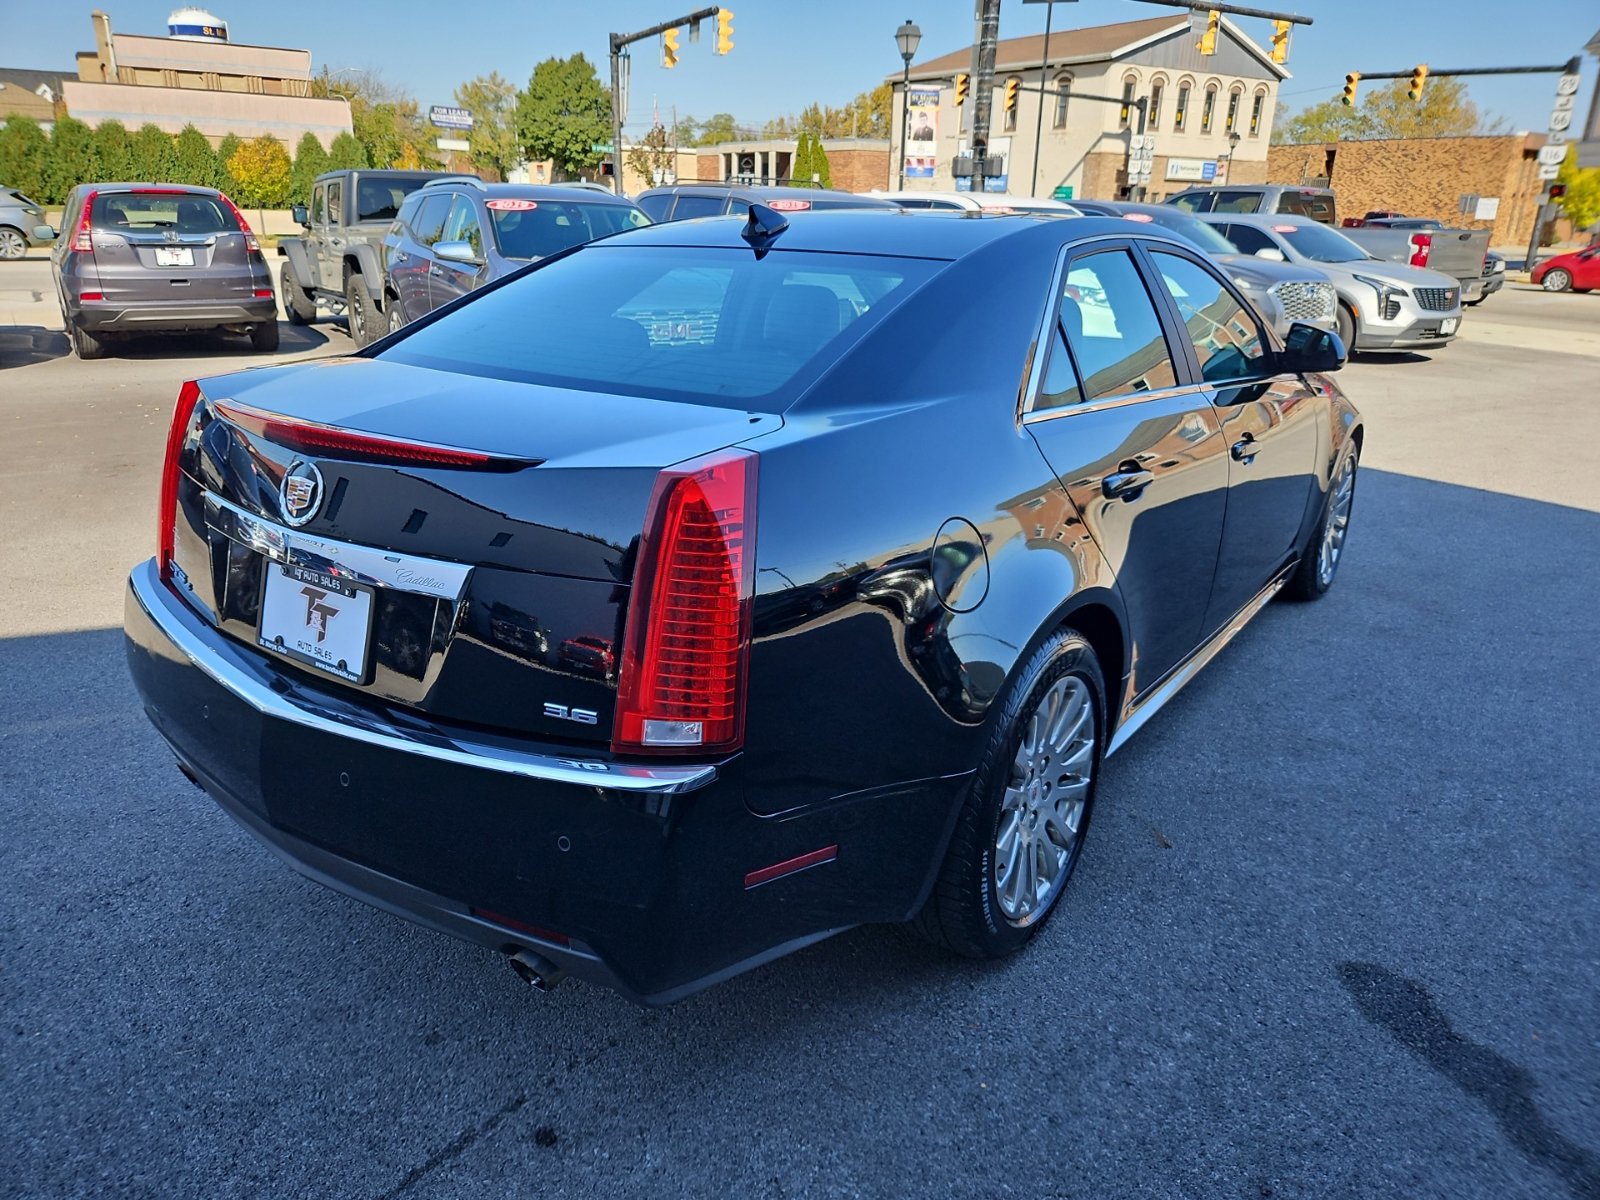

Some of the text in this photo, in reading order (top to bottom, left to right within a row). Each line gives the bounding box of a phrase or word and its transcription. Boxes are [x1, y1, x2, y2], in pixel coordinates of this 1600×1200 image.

[1560, 79, 1576, 90] 29
[1553, 115, 1567, 126] 66
[1544, 149, 1561, 160] 116
[303, 570, 319, 583] AUTO
[320, 576, 341, 590] SALES
[395, 567, 445, 590] Cadillac
[297, 640, 333, 661] AUTO SALES
